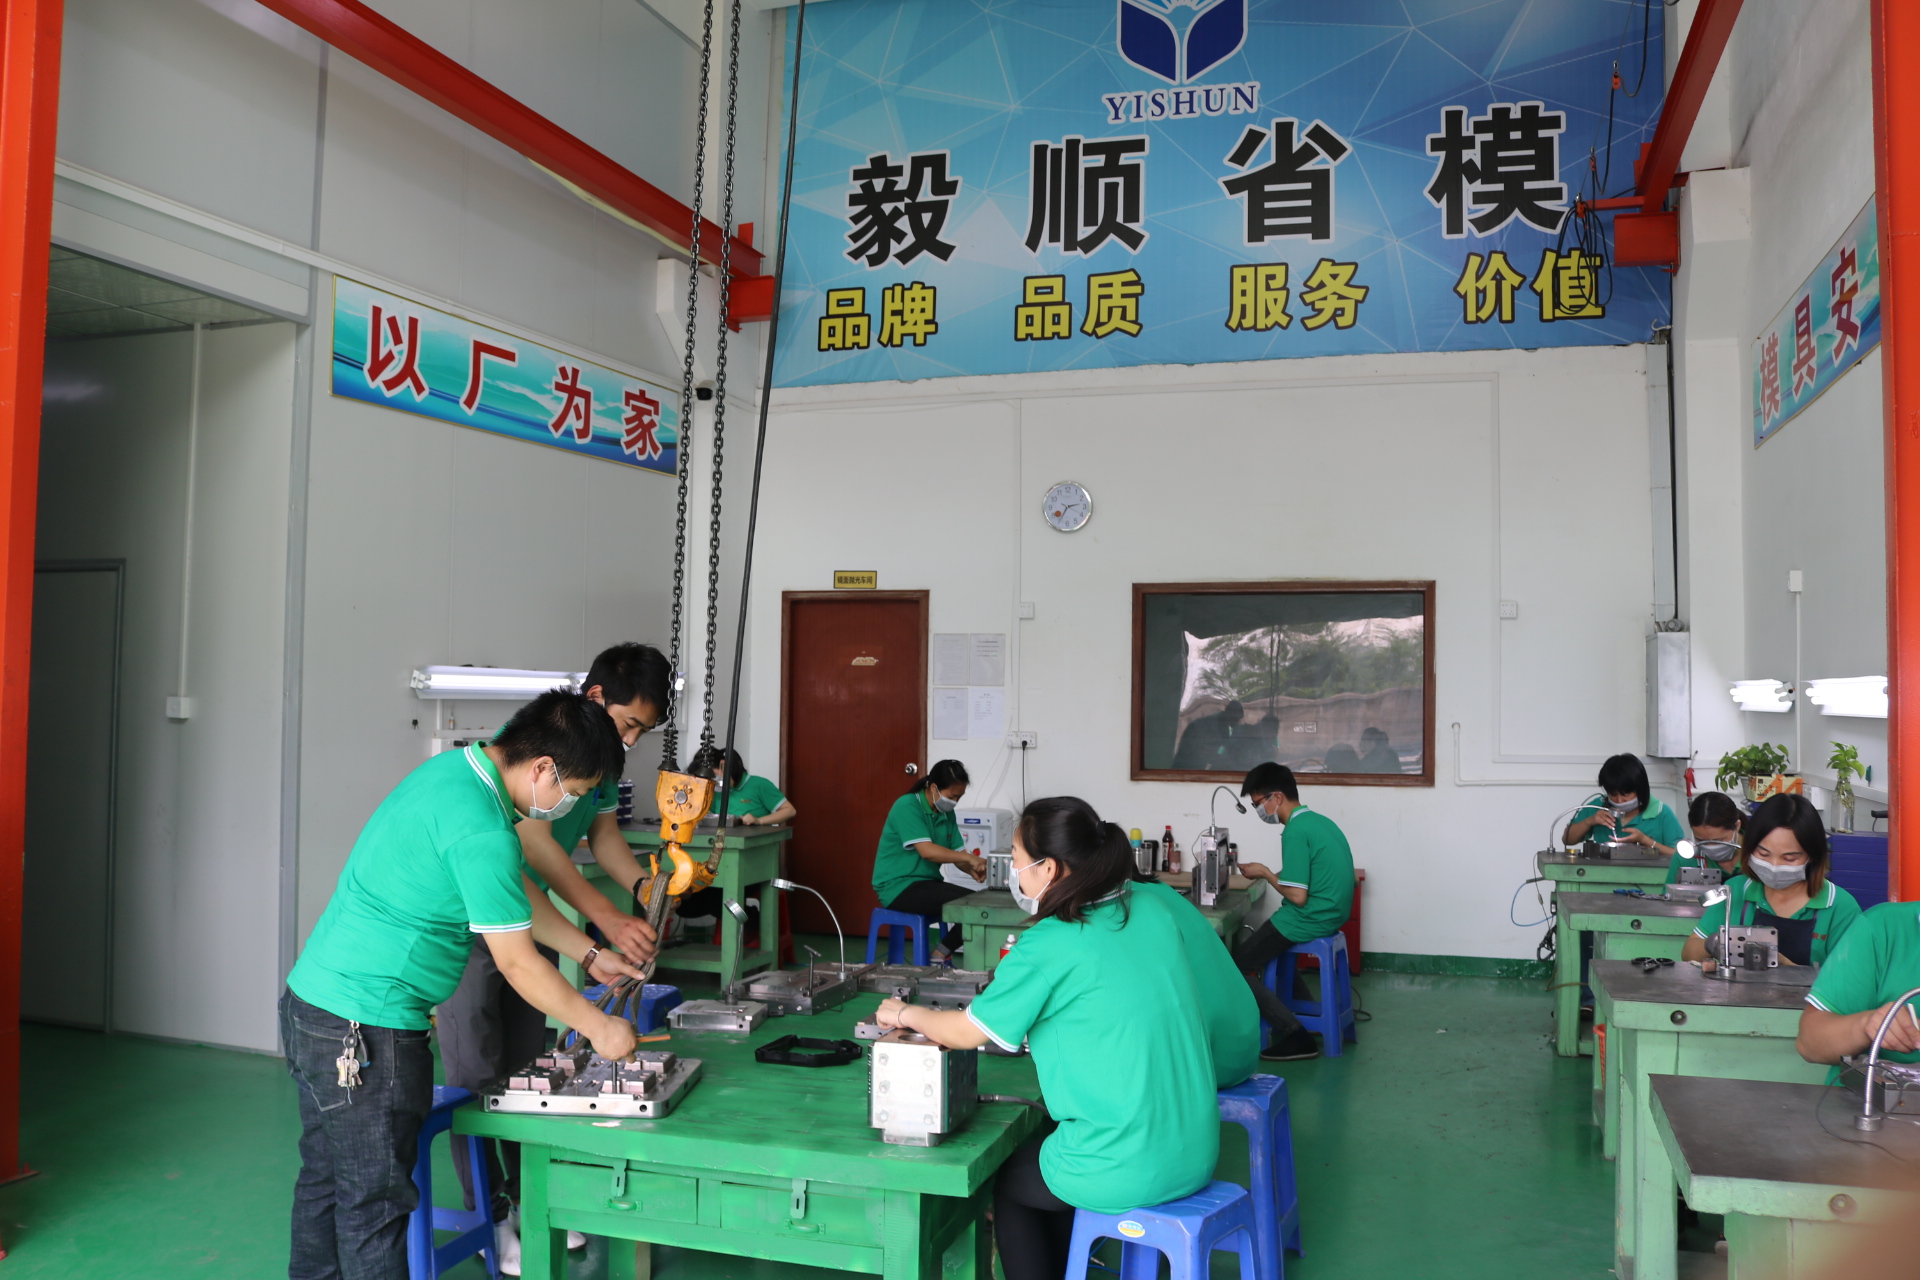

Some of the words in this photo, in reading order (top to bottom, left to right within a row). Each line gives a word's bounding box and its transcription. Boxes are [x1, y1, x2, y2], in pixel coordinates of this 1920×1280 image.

[1104, 84, 1257, 122] YISHUN
[846, 104, 1566, 268] 毅顺省模
[818, 281, 938, 351] 品牌
[1015, 268, 1144, 340] 品质
[1225, 258, 1370, 332] 服务
[1453, 248, 1606, 324] 价值
[366, 304, 661, 457] 以厂为家
